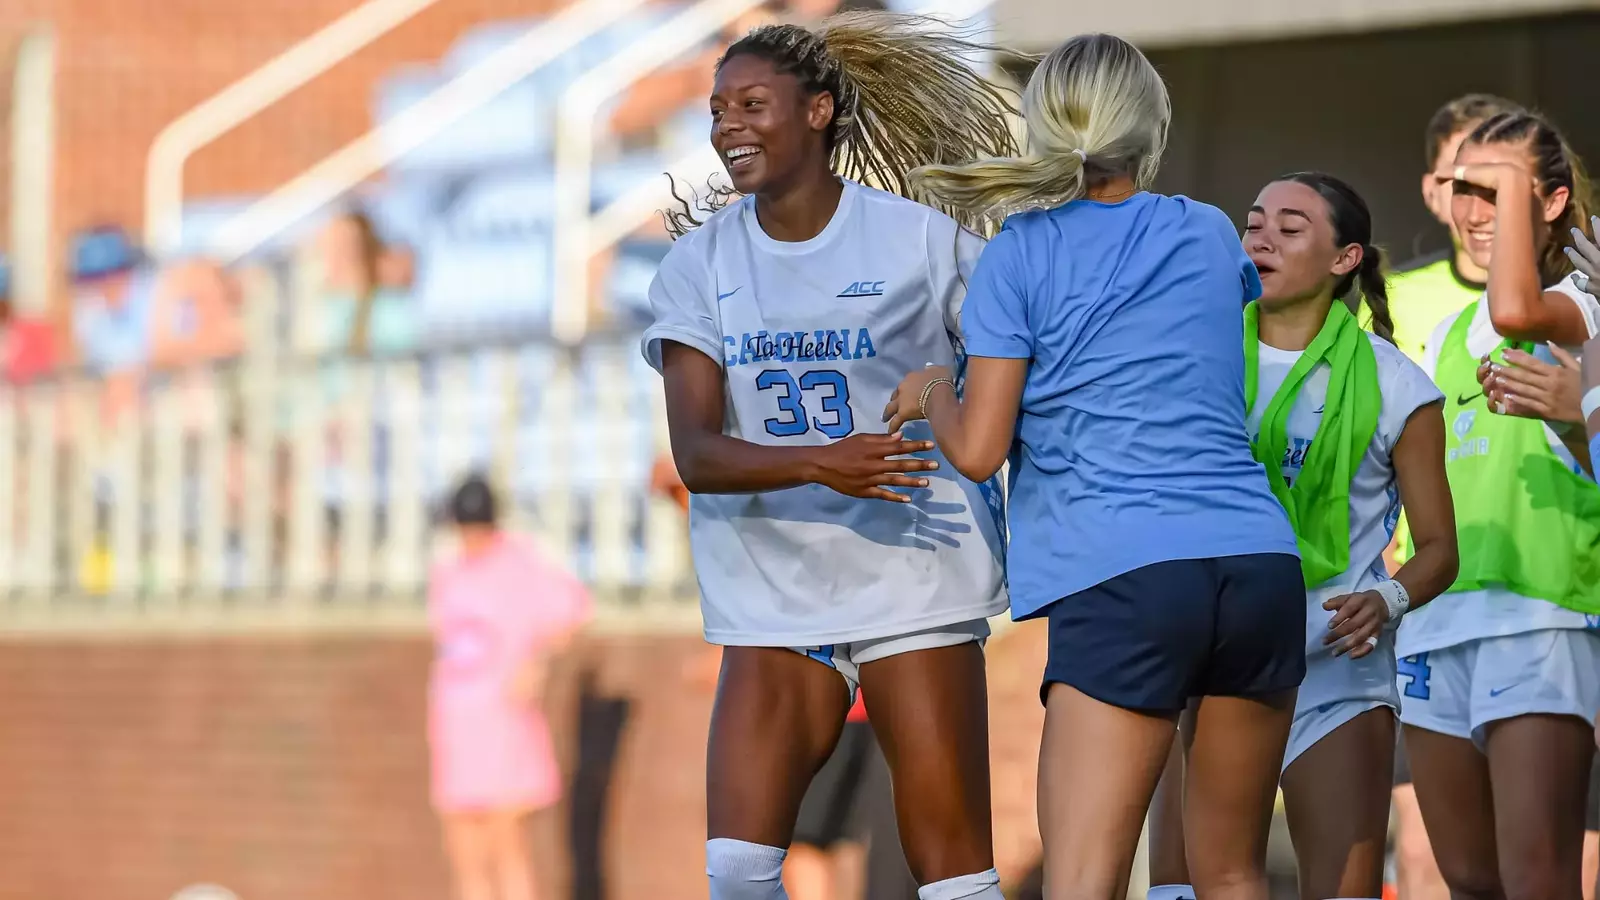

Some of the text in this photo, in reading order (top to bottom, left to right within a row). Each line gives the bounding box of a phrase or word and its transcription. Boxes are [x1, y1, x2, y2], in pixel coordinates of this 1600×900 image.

[840, 280, 886, 295] ACC
[781, 332, 843, 358] Heels
[756, 369, 854, 438] 33
